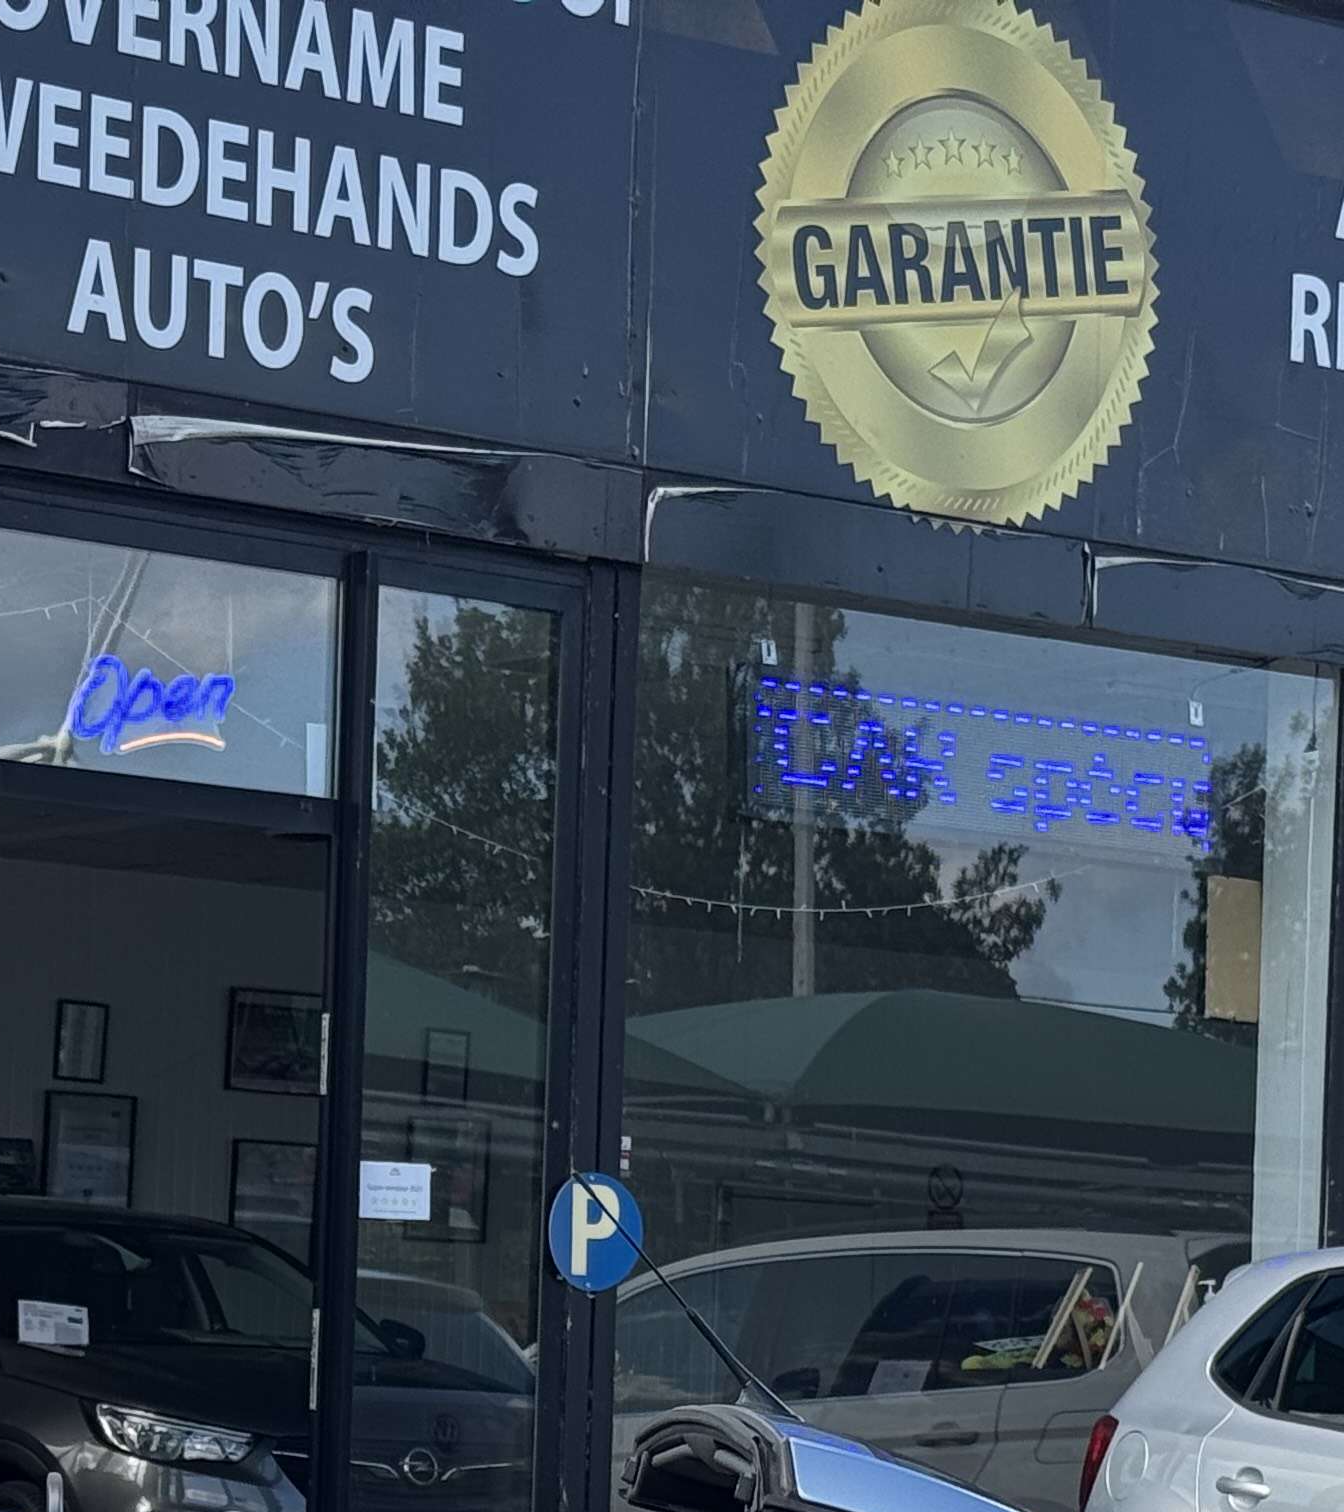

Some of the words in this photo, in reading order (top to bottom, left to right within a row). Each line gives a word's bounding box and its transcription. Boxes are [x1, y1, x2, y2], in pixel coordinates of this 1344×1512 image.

[791, 214, 1132, 312] GARANTIE
[70, 654, 235, 754] Open
[570, 1184, 619, 1277] P
